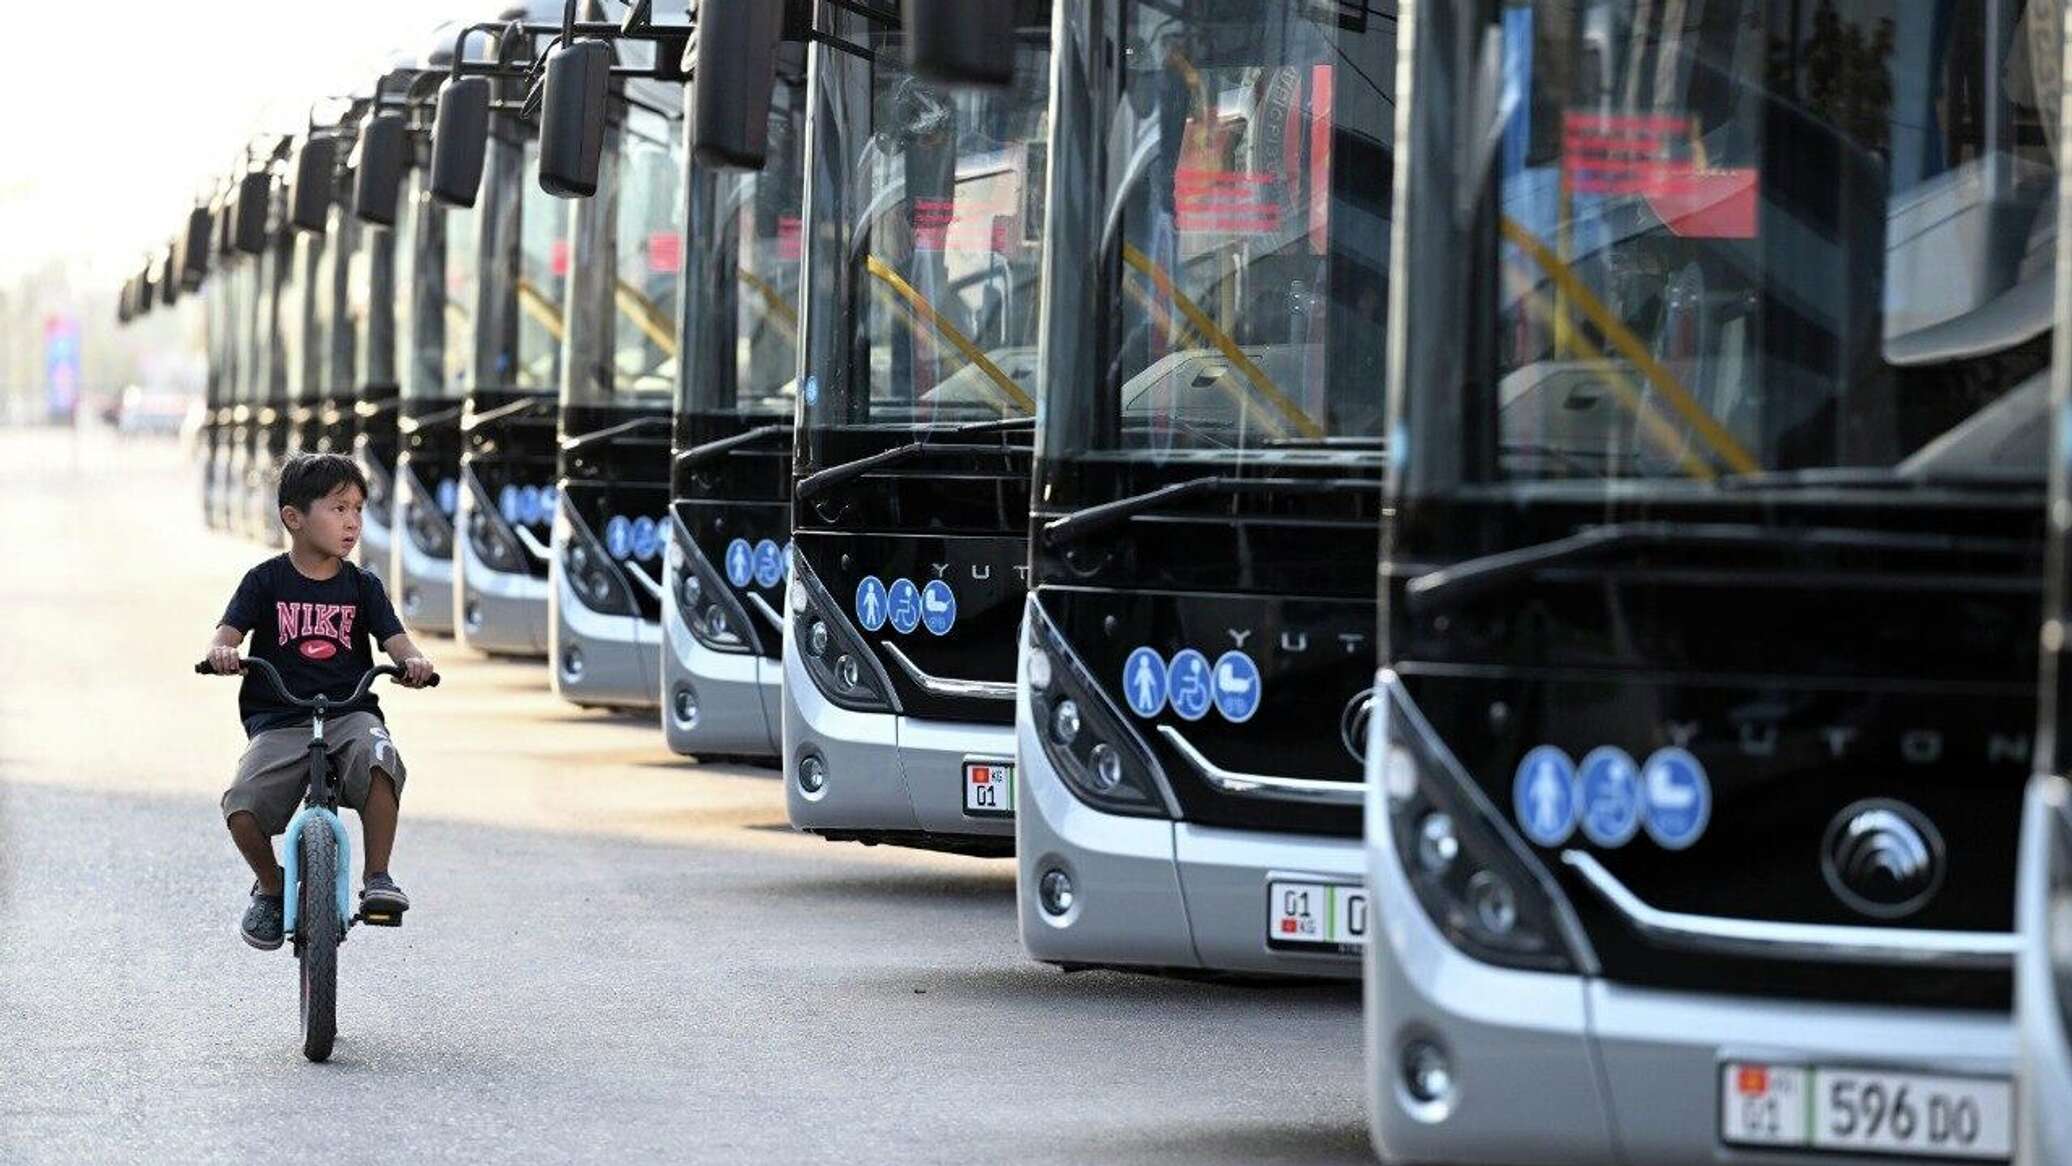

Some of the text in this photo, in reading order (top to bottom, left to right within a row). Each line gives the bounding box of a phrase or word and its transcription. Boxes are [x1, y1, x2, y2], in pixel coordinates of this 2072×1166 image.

[277, 601, 356, 650] NIKE
[976, 785, 996, 807] 01
[1284, 889, 1310, 917] 01
[1830, 1080, 1918, 1140] 596
